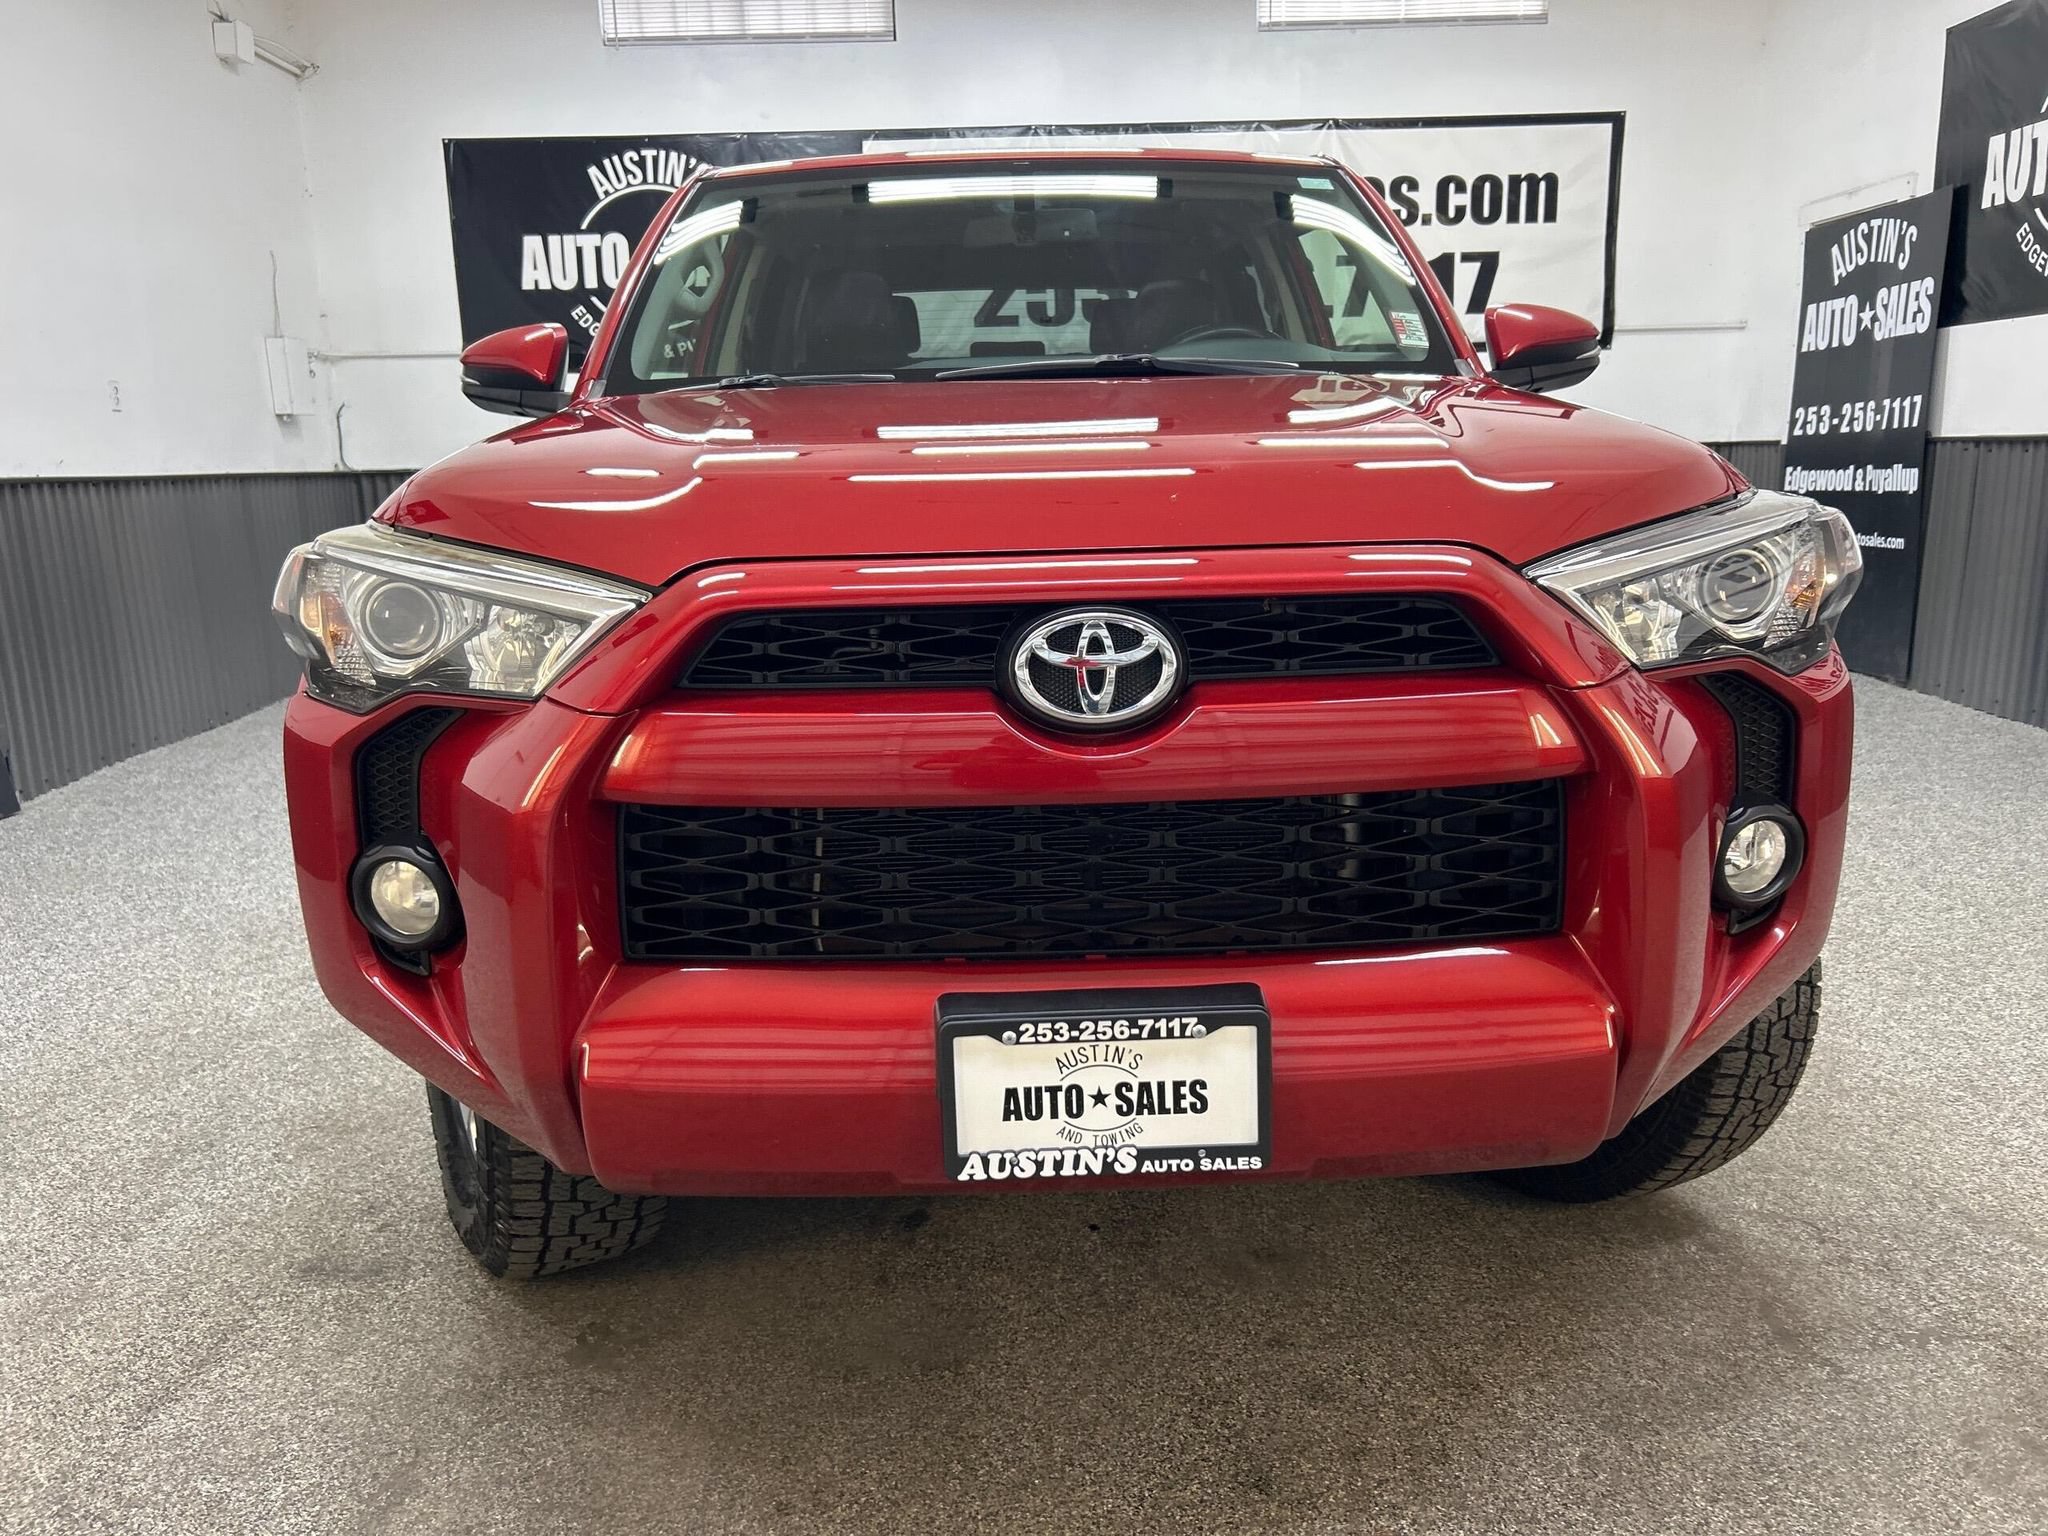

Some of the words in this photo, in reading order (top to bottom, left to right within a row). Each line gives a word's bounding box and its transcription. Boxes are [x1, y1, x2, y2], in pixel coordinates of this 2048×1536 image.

[587, 149, 705, 200] AUSTIN'
[1364, 172, 1559, 227] s.com
[521, 232, 631, 291] AUTO
[1831, 218, 1918, 286] AUSTIN'S
[2015, 222, 2048, 277] EDGE
[1800, 294, 1858, 353] AUTO
[1874, 276, 1935, 341] SALES
[1793, 394, 1923, 436] 253-256-7117
[1784, 465, 1855, 494] Edgewood
[1854, 468, 1864, 491] &
[1865, 463, 1919, 494] Puyallup
[1856, 531, 1905, 550] tosales.com
[1018, 1017, 1199, 1043] 253-256-7117
[1055, 1044, 1144, 1074] AUSTIN'S
[1002, 1083, 1085, 1122] AUTO
[1114, 1078, 1209, 1117] SALES
[1056, 1126, 1083, 1145] AND
[1092, 1121, 1144, 1148] TOWING
[957, 1147, 1138, 1182] AUSTIN'S
[1141, 1159, 1194, 1174] AUTO
[1200, 1156, 1263, 1171] SALES
